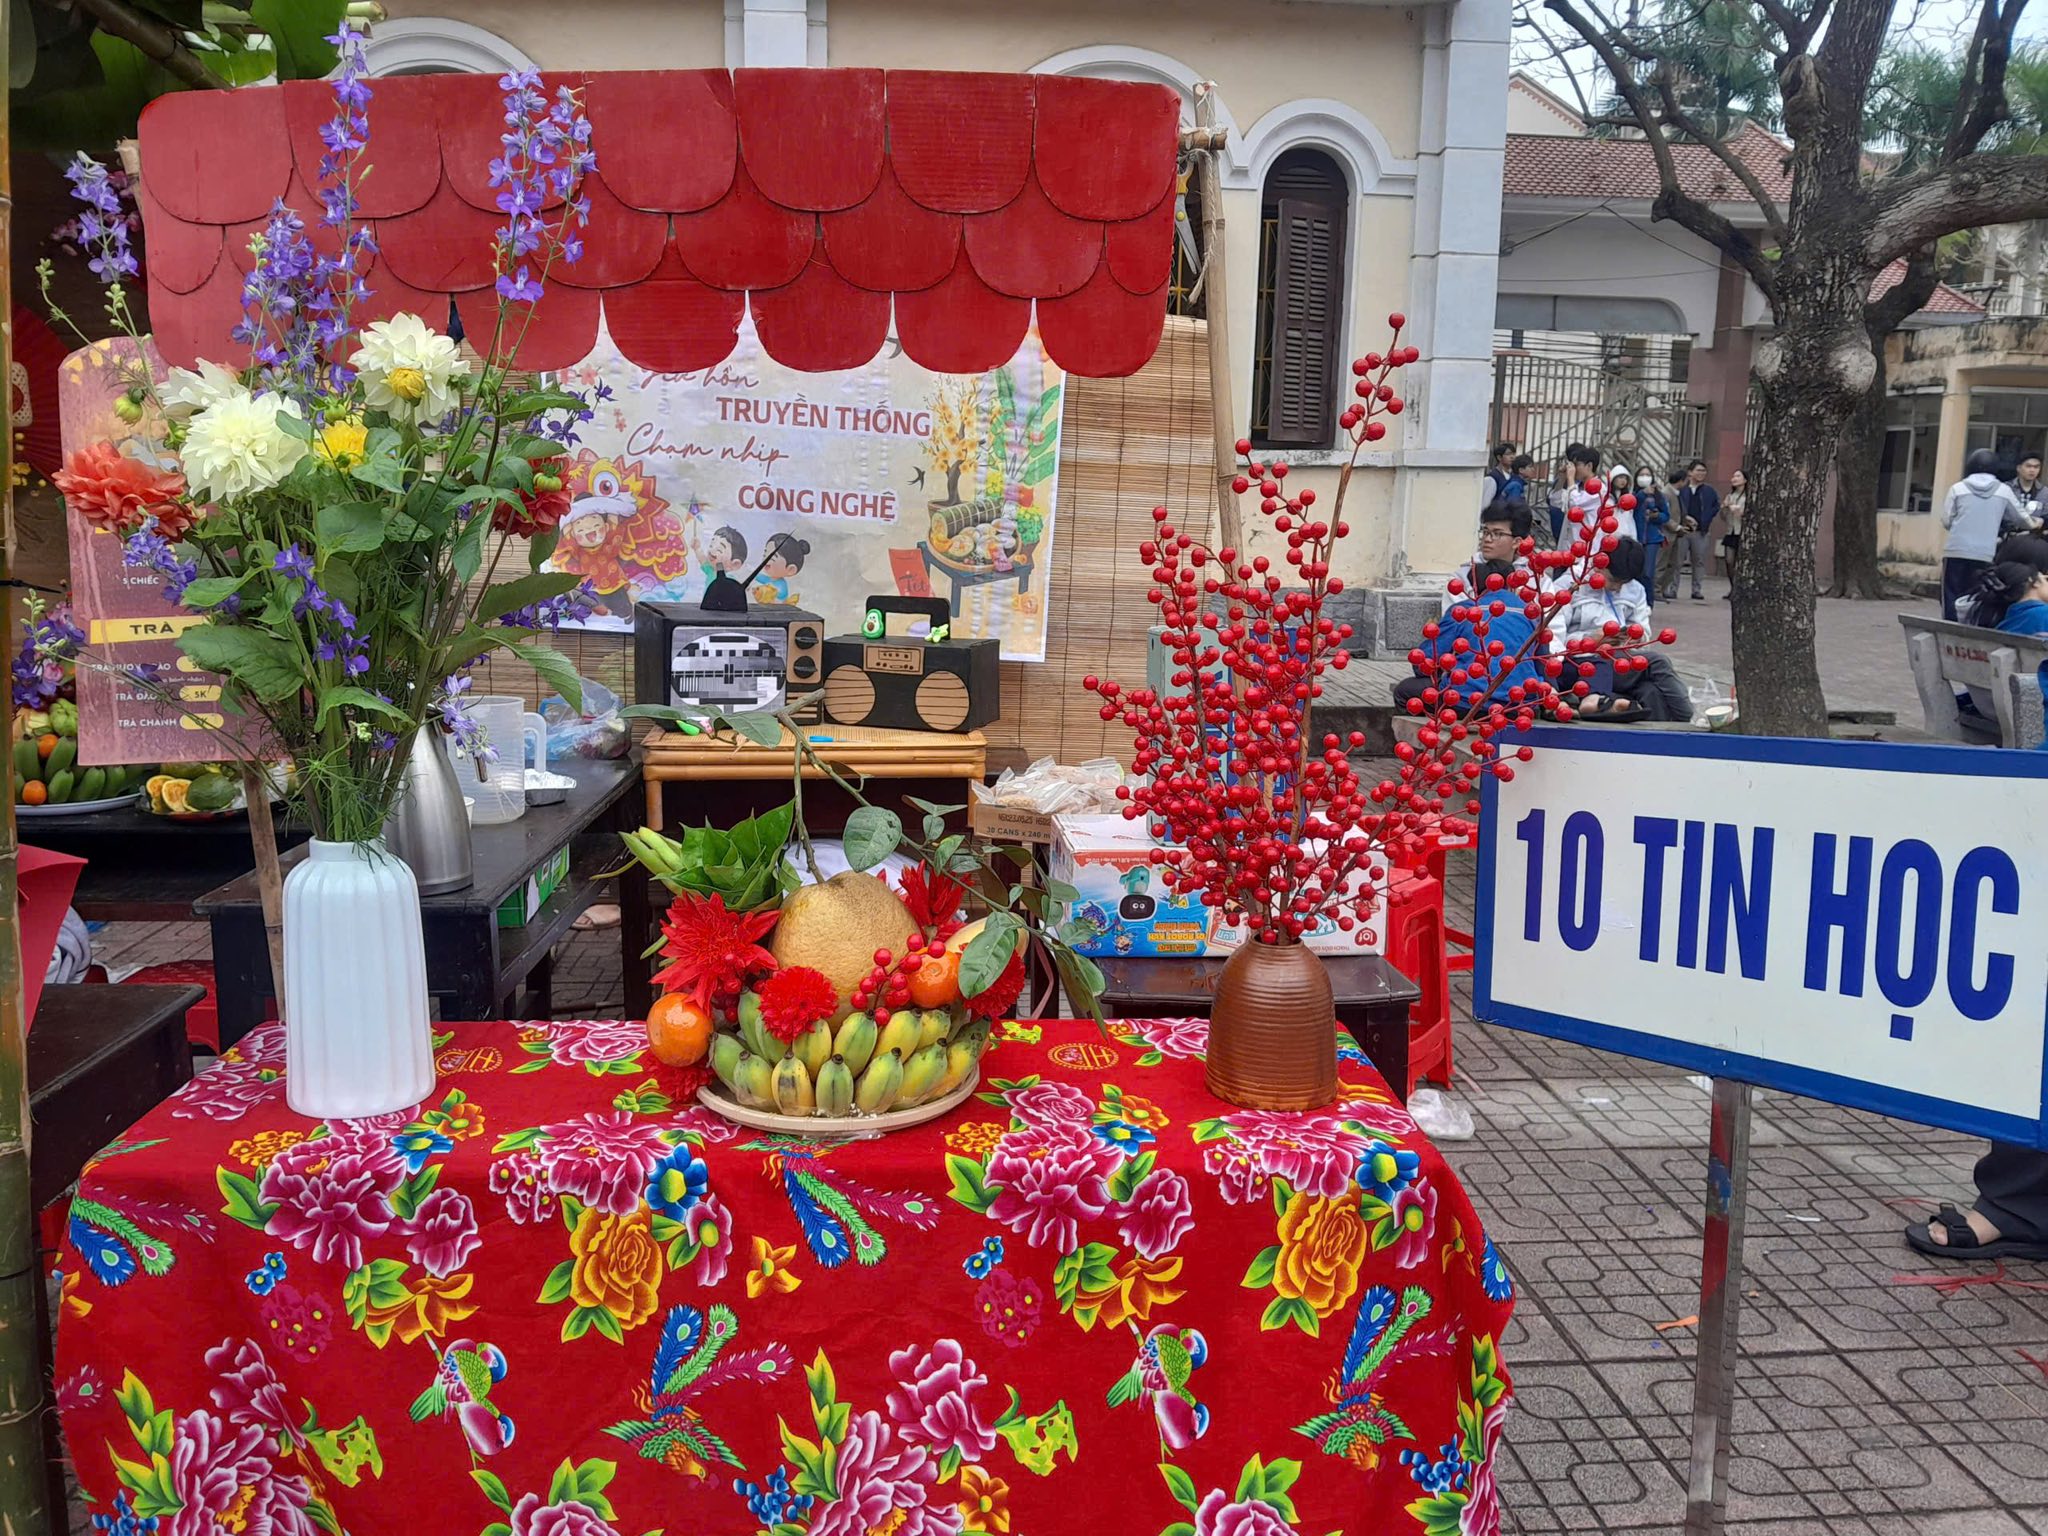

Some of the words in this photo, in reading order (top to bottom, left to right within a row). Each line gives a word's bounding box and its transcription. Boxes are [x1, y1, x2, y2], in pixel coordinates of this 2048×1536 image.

[716, 393, 829, 429] TRUYỀN
[835, 400, 931, 437] THỐNG
[627, 422, 714, 459] Chạm
[721, 435, 789, 477] nhịp
[738, 482, 815, 514] CÔNG
[820, 491, 896, 522] NGHỆ
[130, 575, 160, 585] CHIẾC
[129, 621, 174, 635] TRÀ
[118, 718, 137, 727] TRÀ
[140, 718, 177, 727] CHANH
[997, 827, 1020, 836] CANS
[1516, 808, 1605, 952] 10
[1633, 815, 1776, 982] TIN
[1803, 831, 2021, 1042] HỌC
